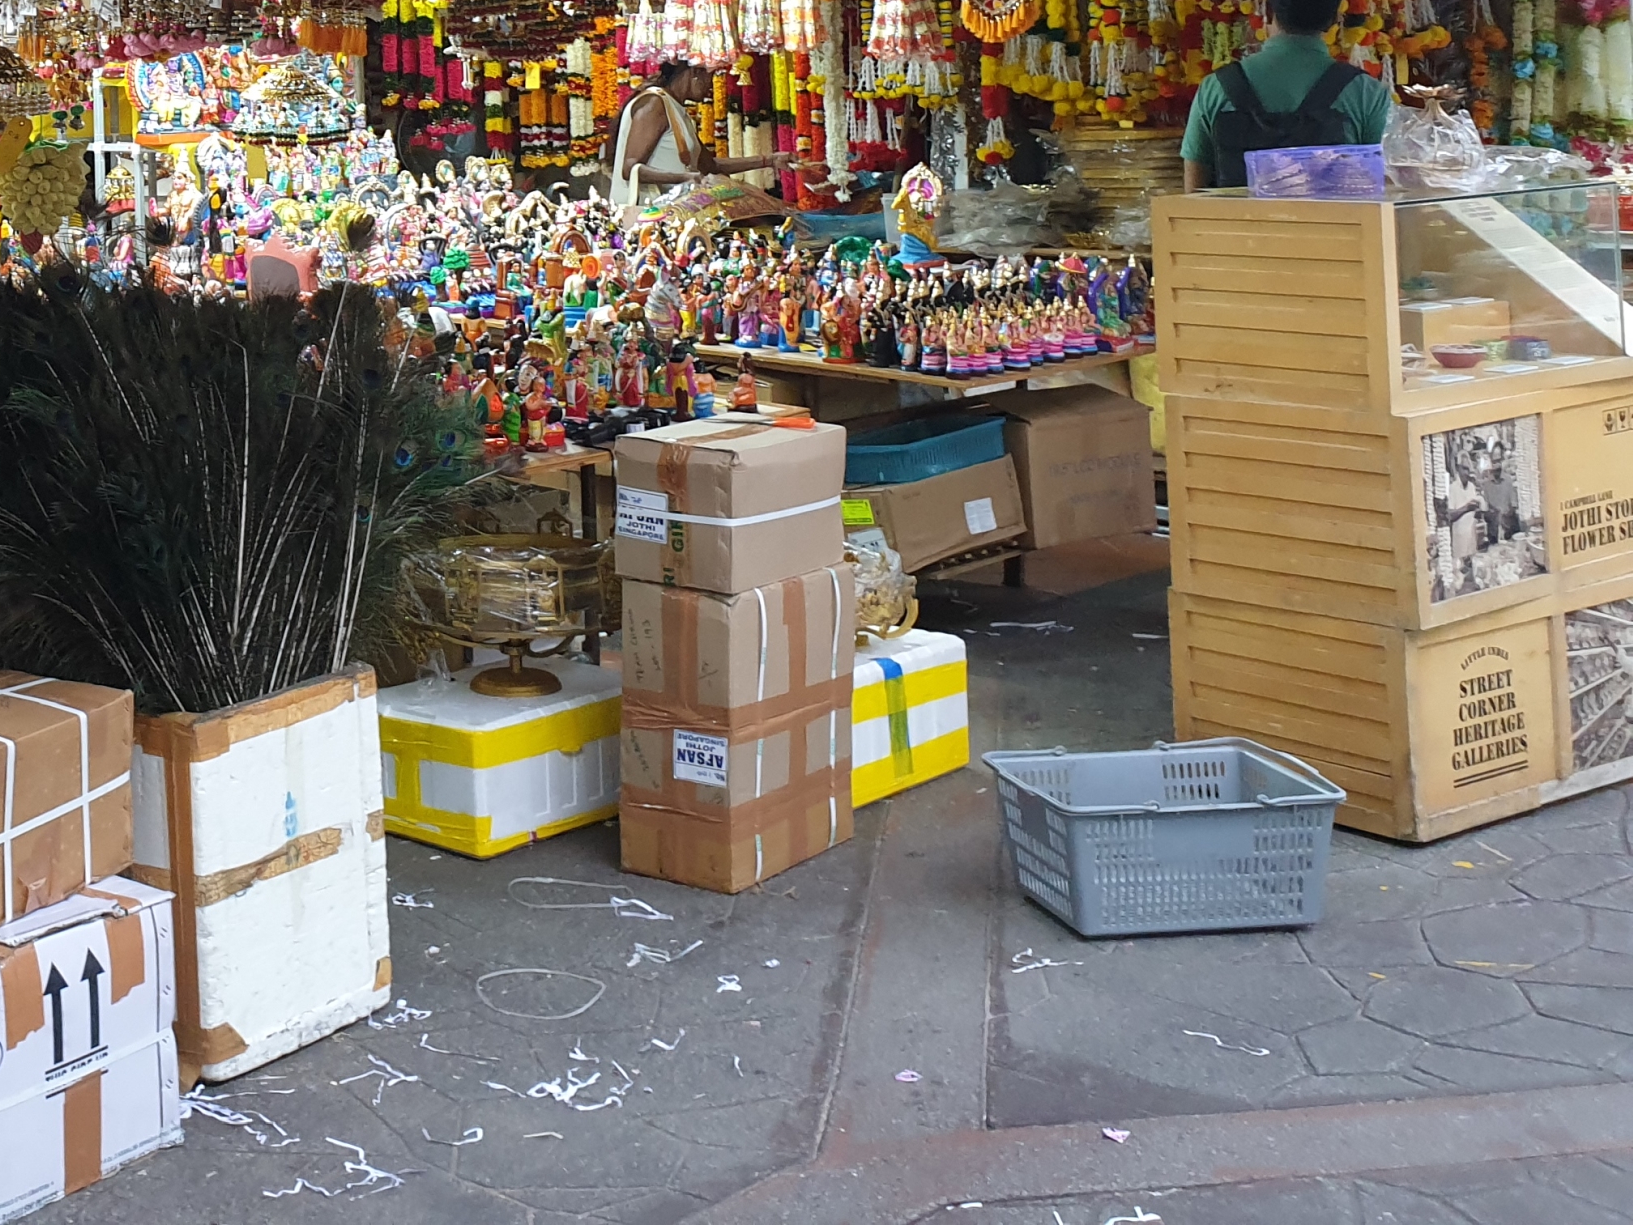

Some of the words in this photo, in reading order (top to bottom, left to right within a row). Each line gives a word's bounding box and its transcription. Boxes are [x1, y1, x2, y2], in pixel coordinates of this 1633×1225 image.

[626, 521, 656, 532] JOTHI
[1562, 505, 1602, 533] JOTHI
[618, 525, 665, 541] SINGAPORE
[1563, 525, 1616, 555] FLOWER
[1460, 646, 1486, 670] LITTLE
[1487, 646, 1509, 661] INDIA
[1459, 669, 1513, 698] STREET
[1459, 692, 1517, 722] CORNER
[677, 732, 725, 747] SINGAPORE
[1453, 712, 1525, 747] HERITAGE
[677, 748, 724, 768] AFSAN
[686, 742, 716, 752] JOTHI
[1451, 734, 1528, 771] GALLERIES
